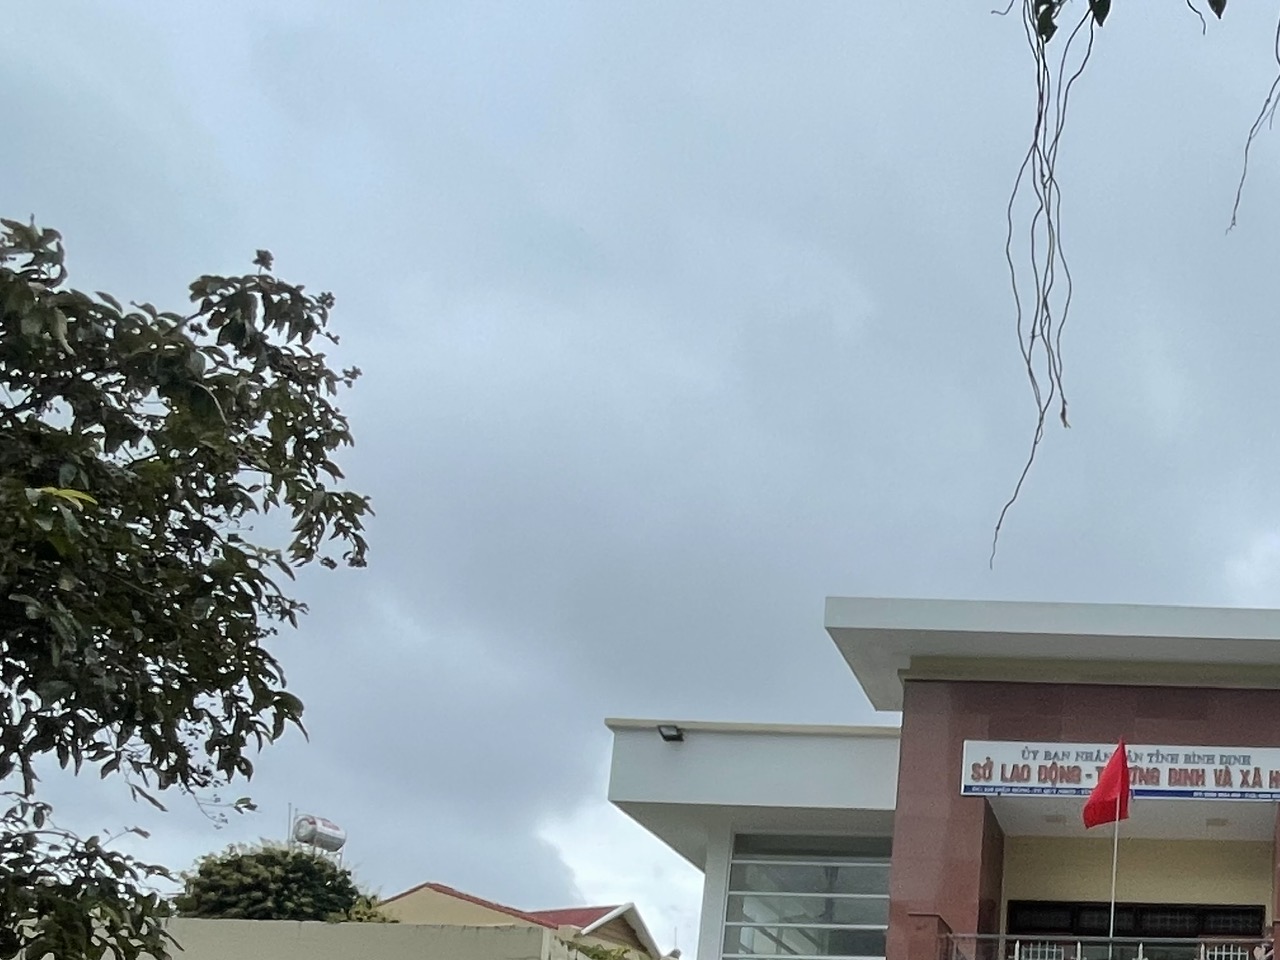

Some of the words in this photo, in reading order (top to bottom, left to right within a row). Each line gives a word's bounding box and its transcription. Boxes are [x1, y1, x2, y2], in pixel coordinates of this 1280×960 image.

[1043, 750, 1070, 761] BAN
[971, 756, 994, 782] SỞ
[1001, 763, 1032, 783] LAO
[1168, 767, 1206, 787] BINH
[1213, 765, 1233, 788] VÀ
